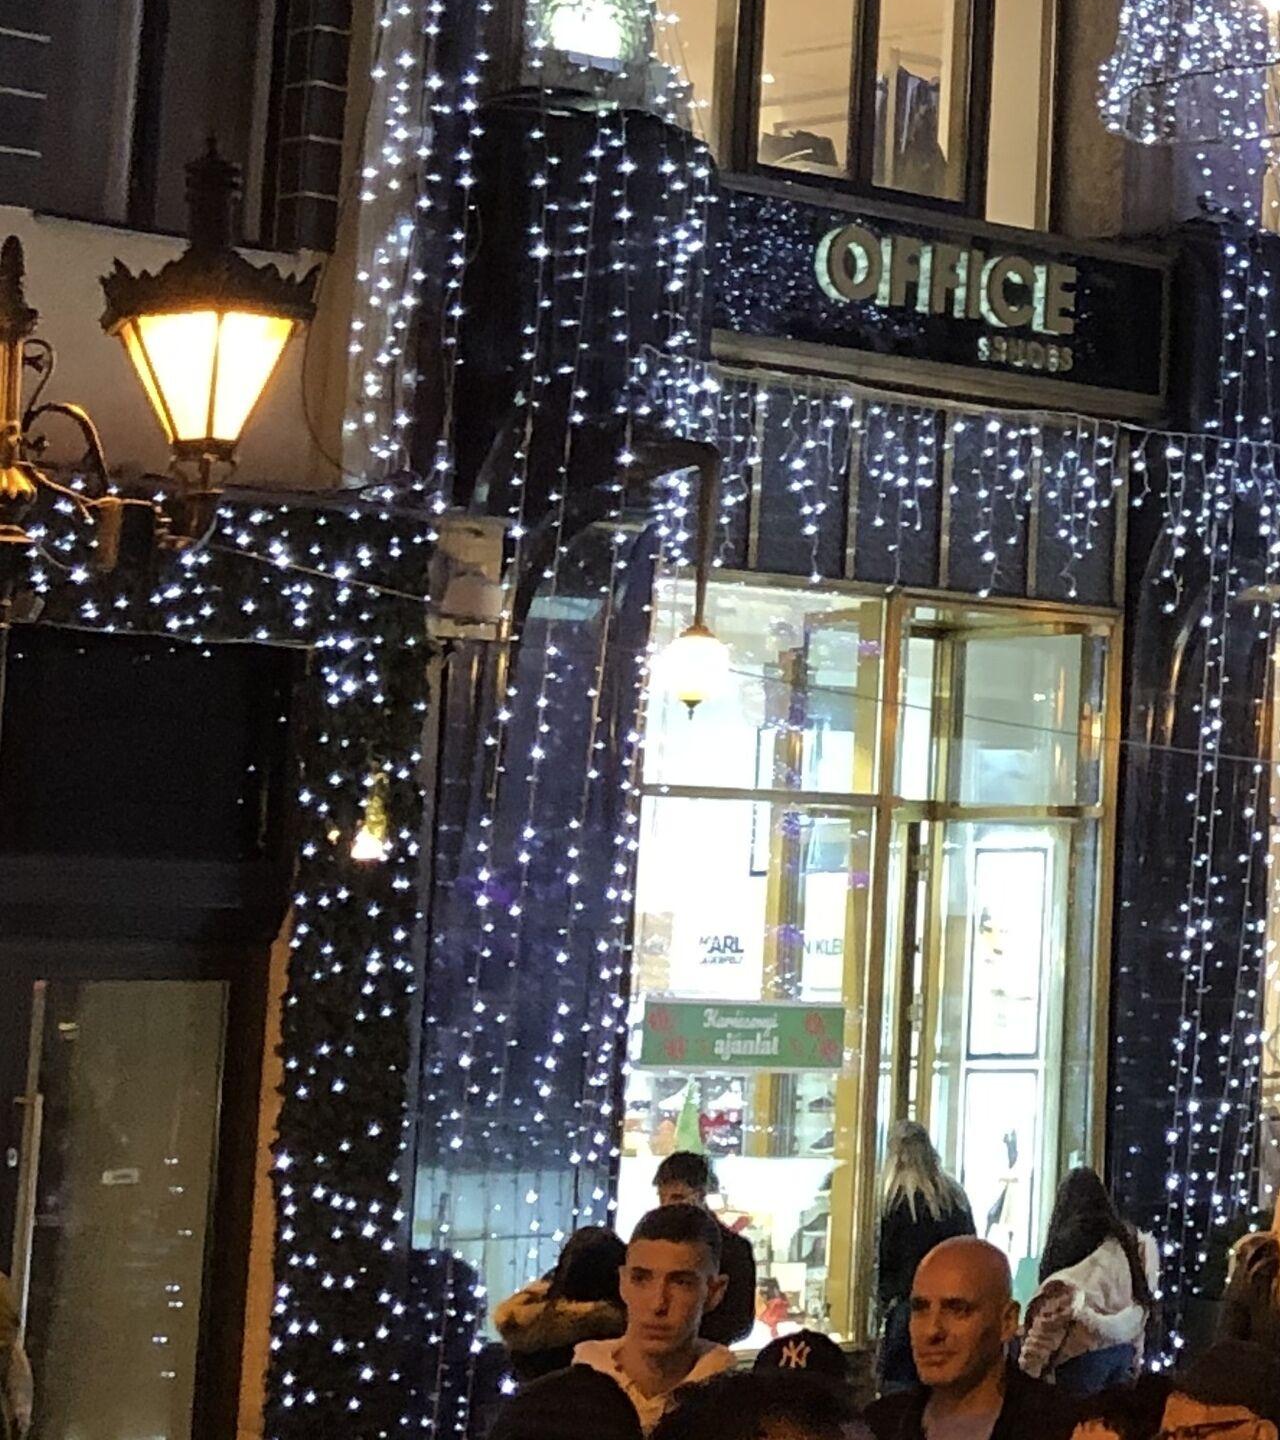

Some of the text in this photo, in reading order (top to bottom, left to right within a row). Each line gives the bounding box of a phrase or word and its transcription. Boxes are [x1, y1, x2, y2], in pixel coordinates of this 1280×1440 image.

[814, 223, 1078, 335] OFFICE
[714, 1032, 780, 1061] ajánlat
[779, 1340, 811, 1368] NY
